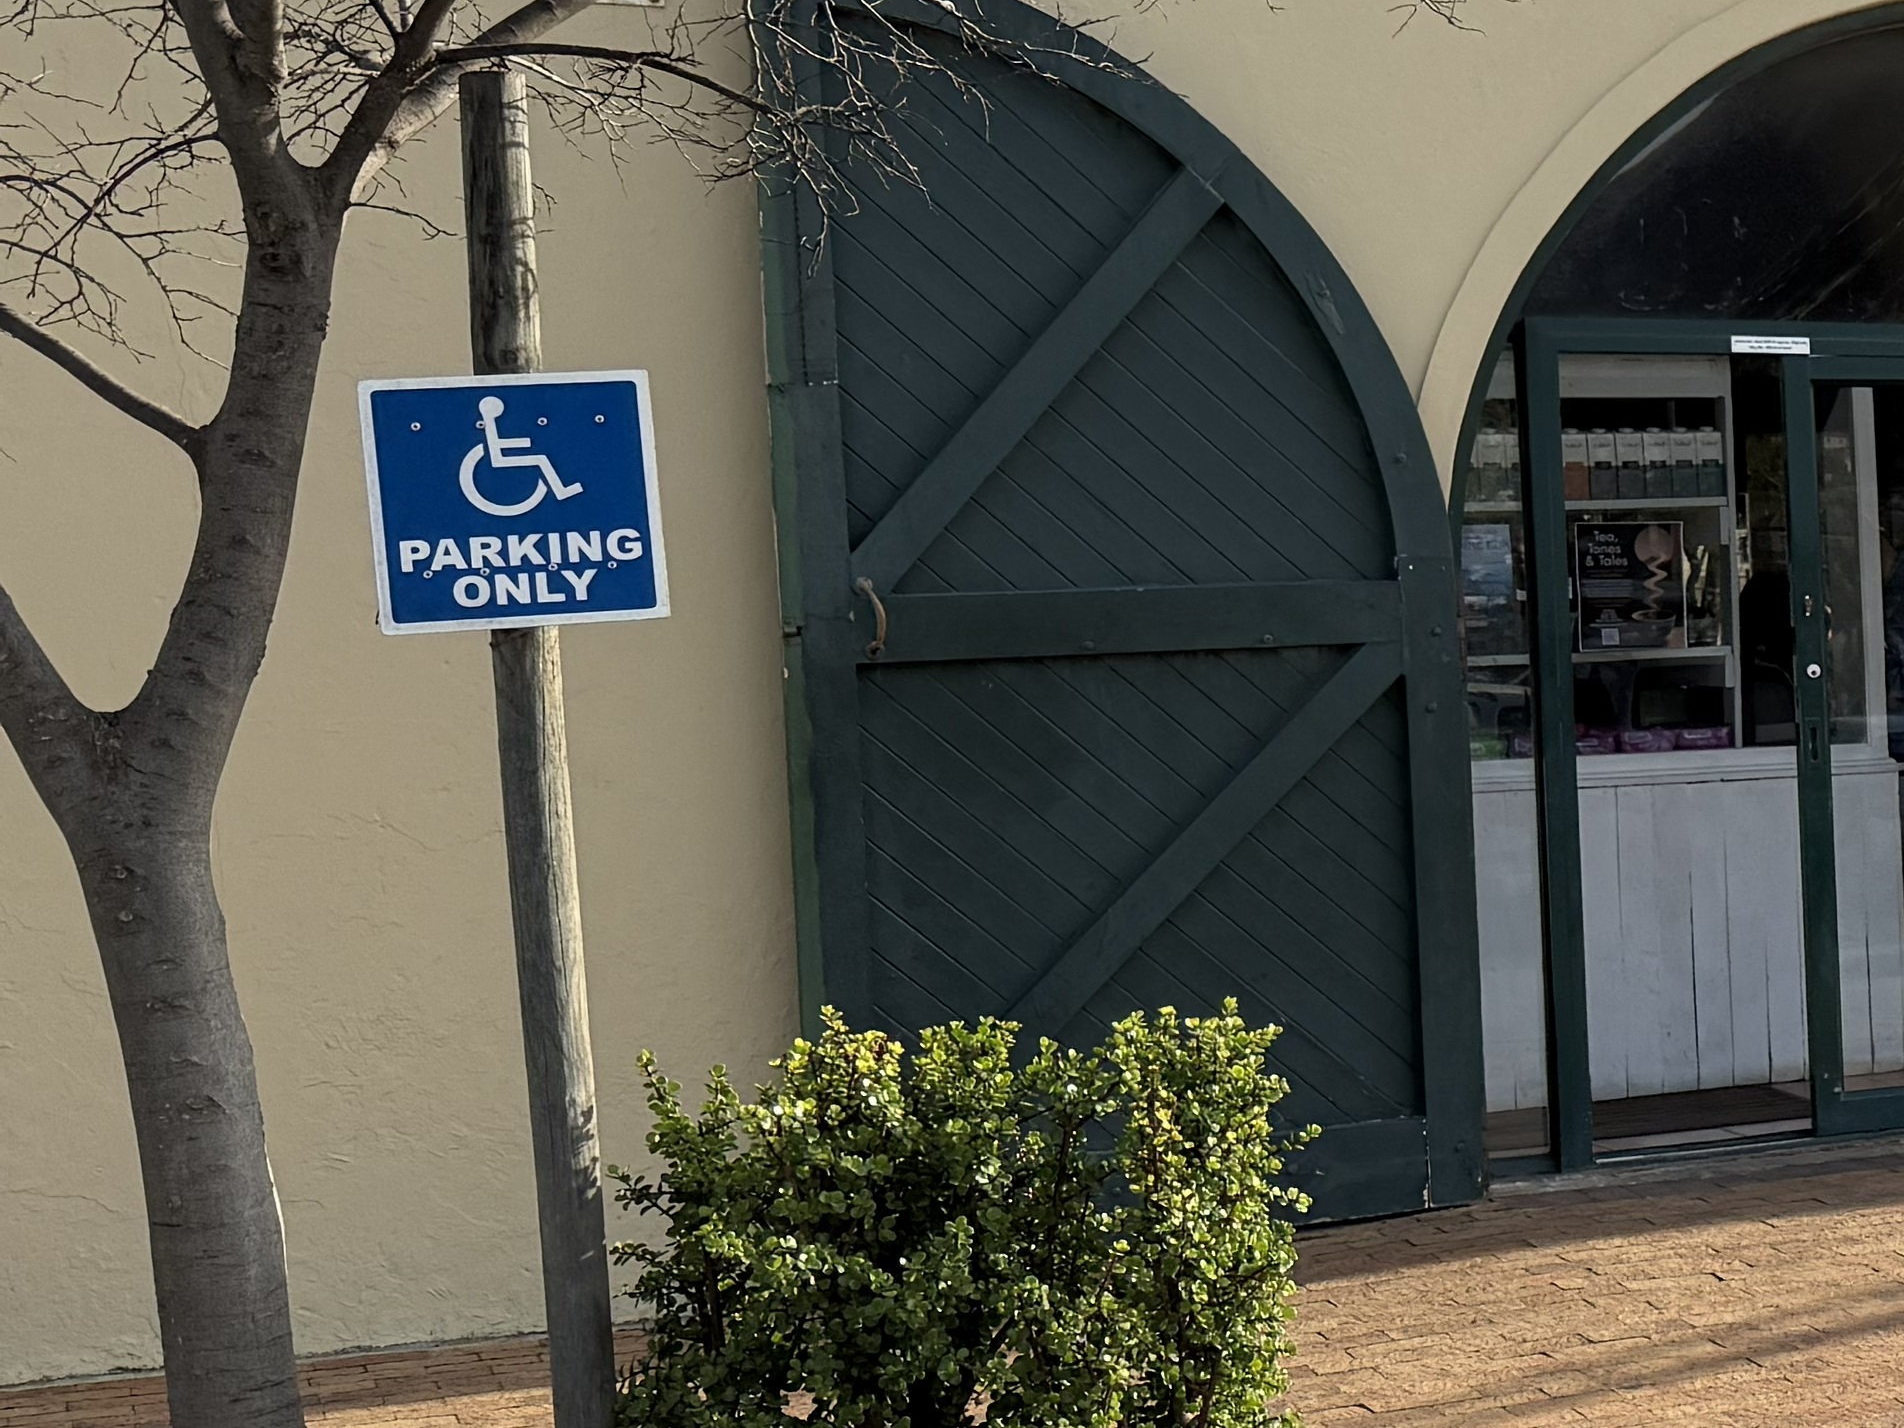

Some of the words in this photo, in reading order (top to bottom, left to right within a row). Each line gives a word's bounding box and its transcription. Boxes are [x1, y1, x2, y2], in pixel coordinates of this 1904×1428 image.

[1593, 530, 1618, 544] Tea,
[399, 528, 643, 573] PARKING
[1585, 555, 1595, 567] &
[1598, 555, 1628, 567] Tales
[453, 569, 598, 608] ONLY
